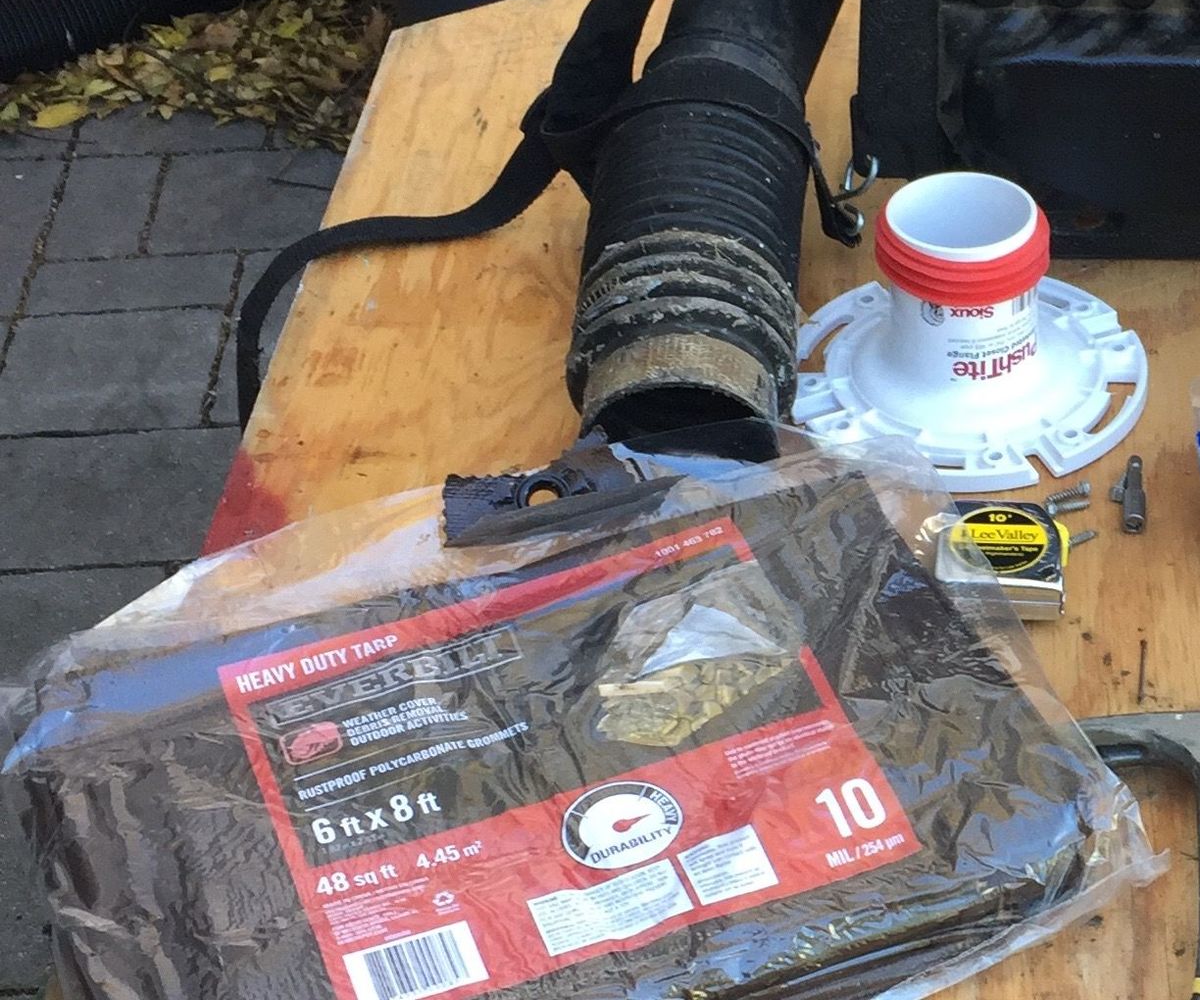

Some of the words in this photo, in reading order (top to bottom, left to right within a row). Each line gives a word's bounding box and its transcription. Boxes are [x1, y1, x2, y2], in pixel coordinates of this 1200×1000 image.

[950, 306, 994, 319] Sioux
[971, 529, 995, 539] Lee
[996, 529, 1039, 542] Valley
[236, 661, 296, 694] HEAVY
[300, 647, 349, 676] DUTY
[351, 634, 399, 660] TARP
[278, 637, 506, 719] EVERBILT
[342, 705, 398, 728] WEATHER
[398, 697, 438, 713] COVER
[346, 719, 393, 737] DEBRIS
[393, 706, 445, 727] REMOVAL
[350, 725, 405, 747] OUTDOOR
[407, 711, 470, 732] ACTIVITIES
[298, 769, 367, 801] RUSTPROOF
[369, 740, 466, 777] POLYCARBONATE
[467, 721, 529, 749] GROMMETS
[311, 817, 336, 844] 6
[339, 816, 365, 838] ft
[389, 792, 414, 823] 8
[416, 792, 442, 815] ft
[651, 788, 679, 824] HEAVY
[814, 777, 887, 838] 10
[590, 825, 674, 864] DURABILITY
[825, 850, 855, 868] MIL
[861, 839, 885, 857] 254
[316, 871, 350, 896] 48
[353, 870, 380, 888] sq
[379, 863, 399, 881] ft
[416, 845, 461, 869] 4.45
